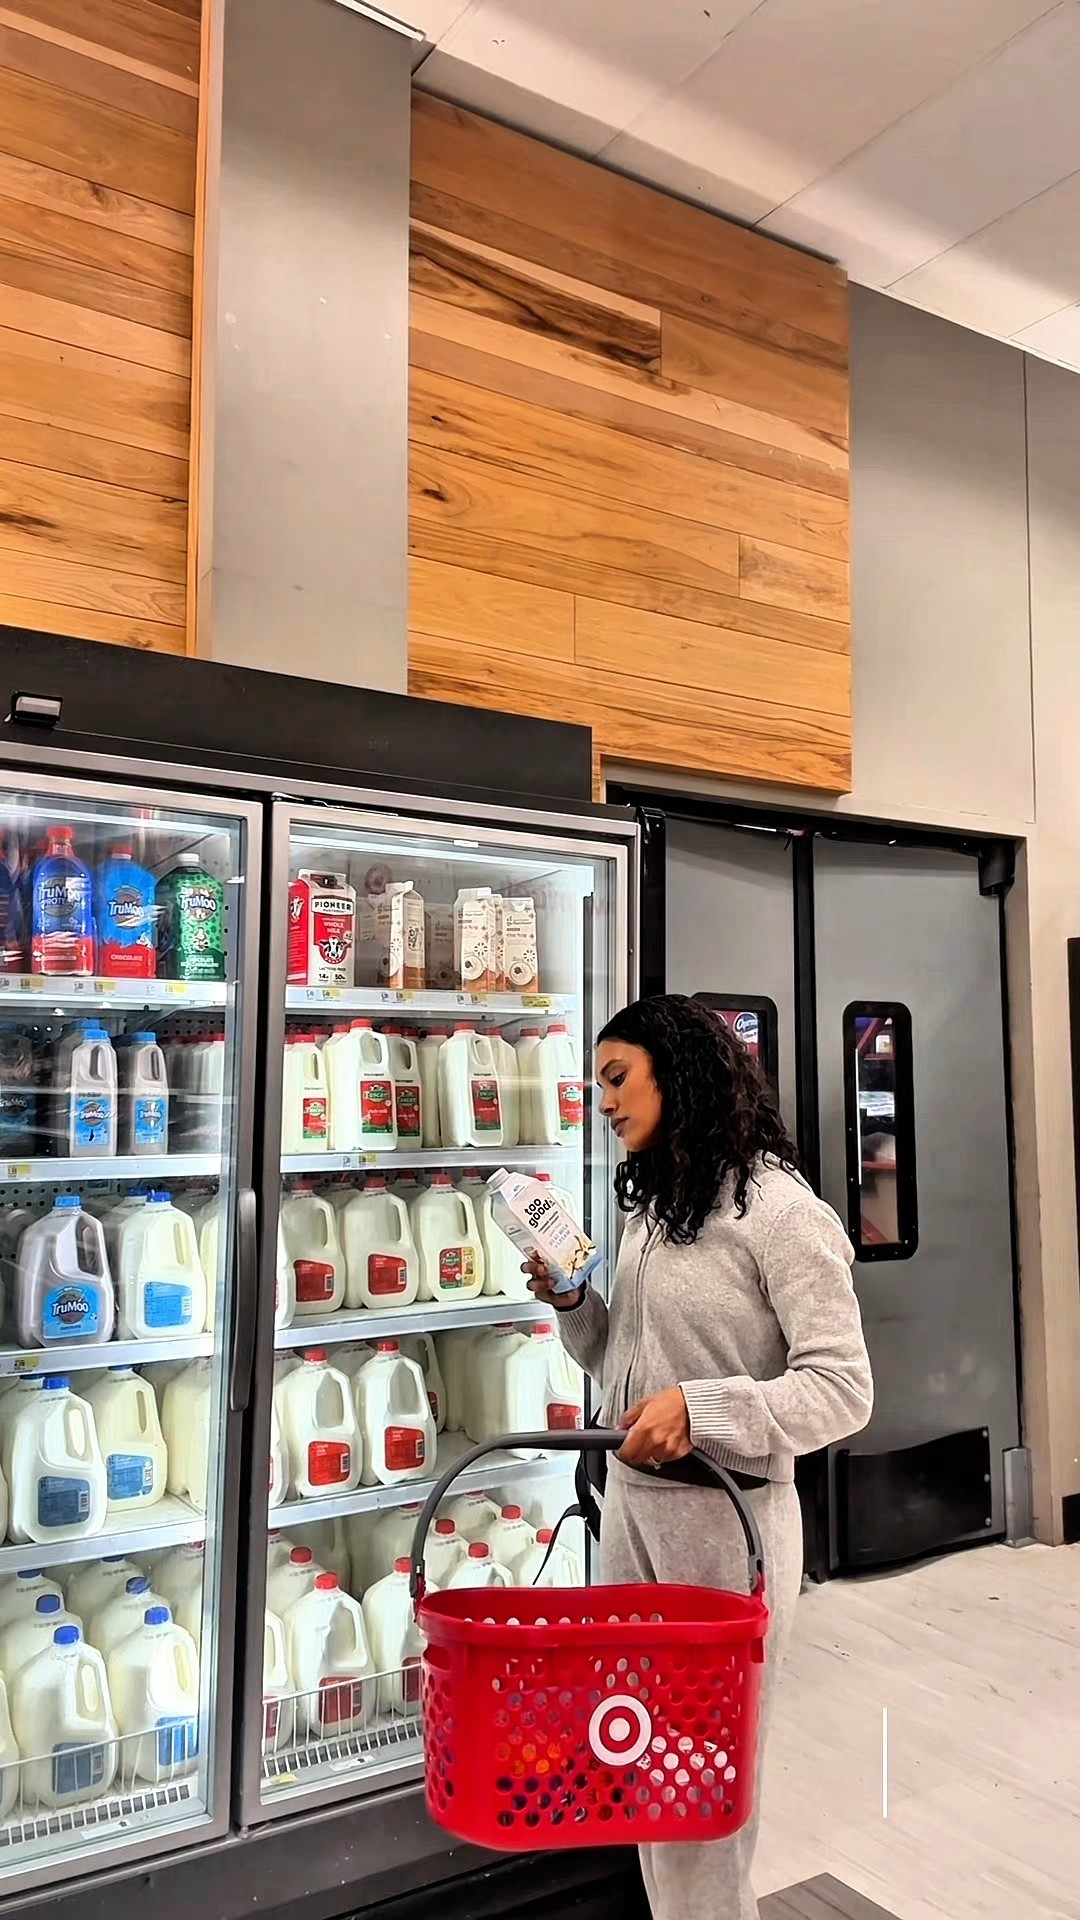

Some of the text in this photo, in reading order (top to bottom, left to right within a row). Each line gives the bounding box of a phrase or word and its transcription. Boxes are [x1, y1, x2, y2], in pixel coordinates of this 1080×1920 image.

[108, 901, 145, 918] TruMoo
[180, 894, 216, 911] TruMoo
[314, 901, 352, 911] PIONEER
[524, 1198, 542, 1216] too
[528, 1199, 552, 1229] good
[52, 1300, 89, 1316] TruMoo
